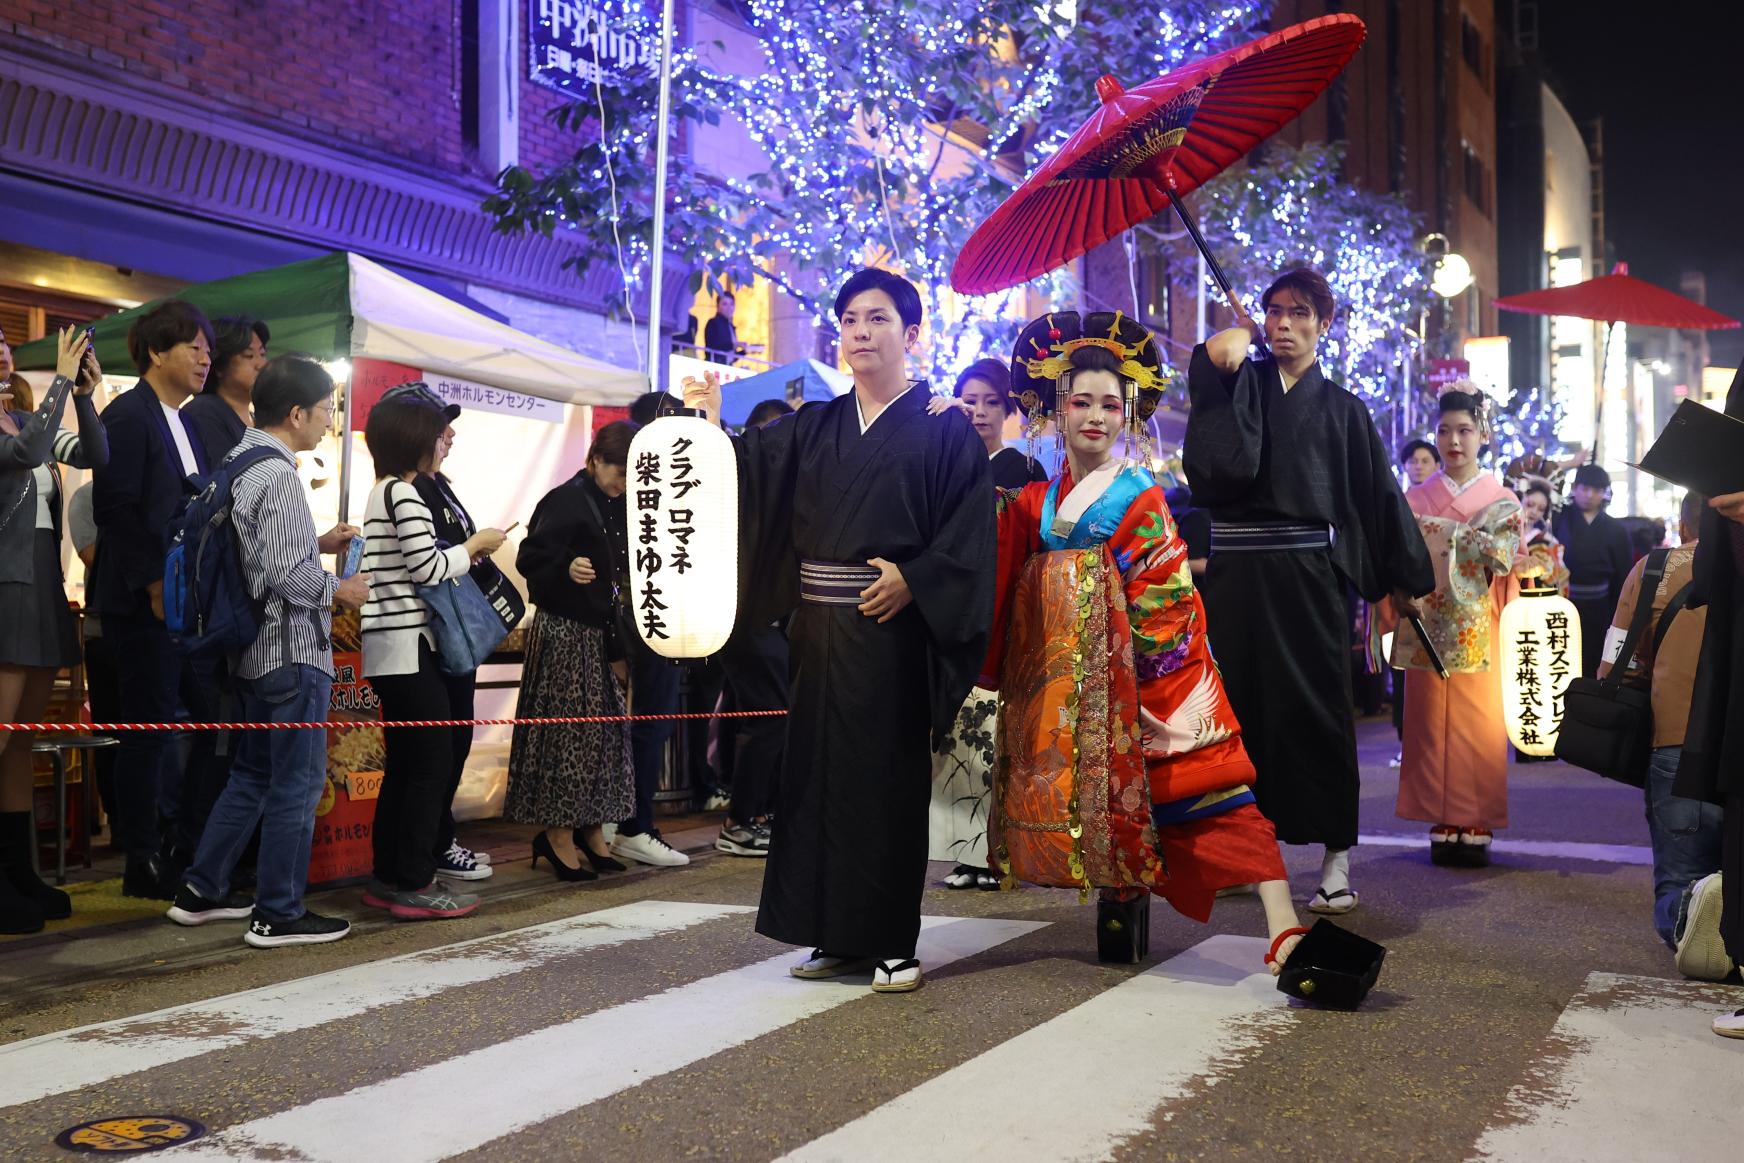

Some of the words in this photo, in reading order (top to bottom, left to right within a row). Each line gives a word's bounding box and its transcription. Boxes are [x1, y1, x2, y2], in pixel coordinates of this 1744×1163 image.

[438, 381, 546, 410] 中洲ホルモンセンター
[670, 437, 701, 499] クラブ
[635, 451, 670, 640] 柴田まゆ太夫
[668, 508, 695, 575] ロマネ
[1516, 630, 1544, 745] 工業株式会社
